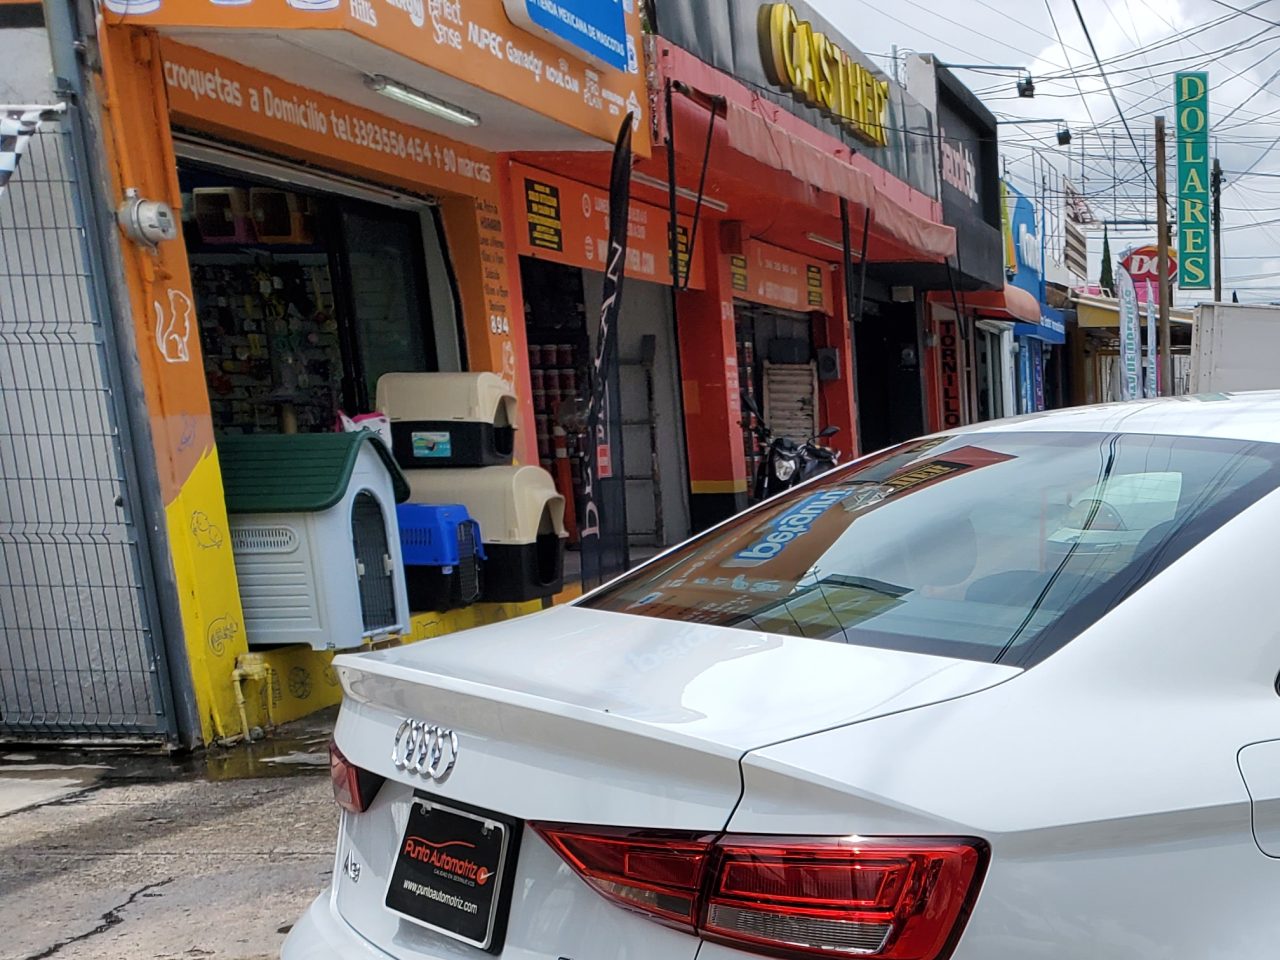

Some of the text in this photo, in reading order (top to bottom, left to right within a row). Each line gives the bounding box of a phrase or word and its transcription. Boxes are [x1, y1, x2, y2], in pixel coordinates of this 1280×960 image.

[468, 21, 503, 59] NUPEC
[558, 6, 586, 37] MEXICANA
[757, 3, 888, 147] CASTHER
[164, 61, 242, 107] croquetas
[249, 87, 259, 112] a
[263, 86, 328, 135] Domicilio
[442, 147, 456, 173] 90
[457, 157, 491, 183] marcas
[1179, 76, 1206, 283] DOLARES
[490, 315, 509, 335] 894
[404, 840, 478, 879] Punto Automotriz
[403, 880, 478, 914] www.puntoautomotriz.com
